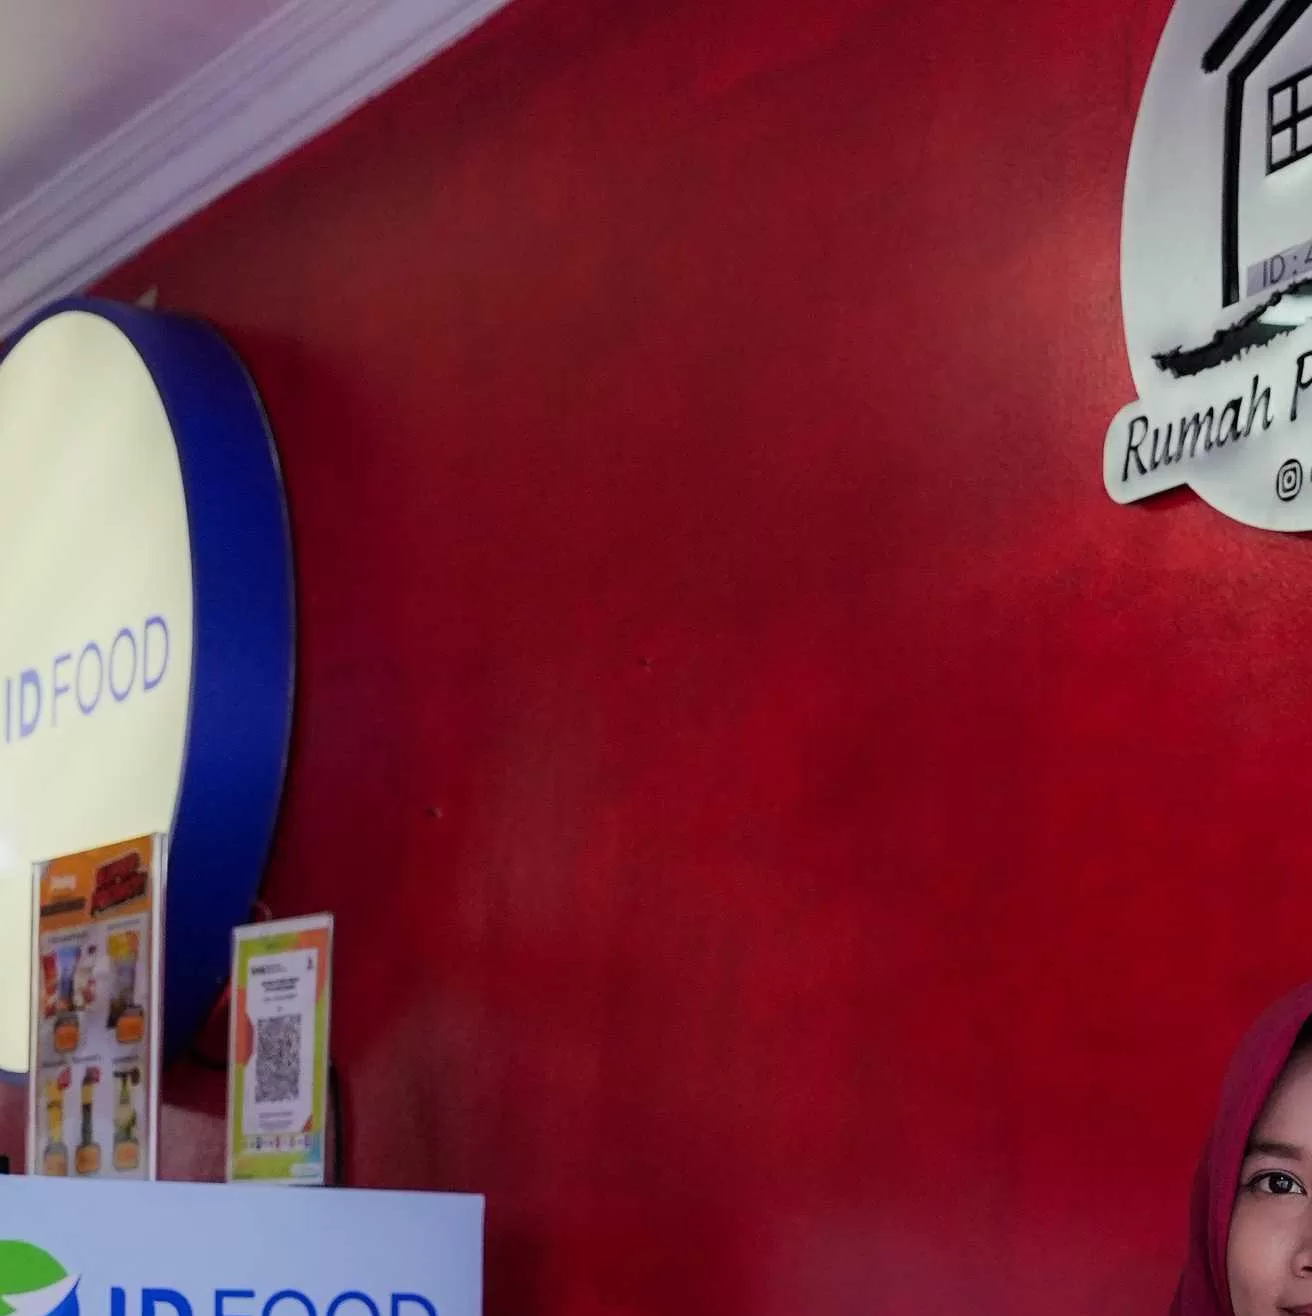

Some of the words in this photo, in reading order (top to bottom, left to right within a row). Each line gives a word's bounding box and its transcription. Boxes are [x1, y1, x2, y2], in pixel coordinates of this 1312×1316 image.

[1262, 253, 1286, 287] ID
[1122, 374, 1274, 482] Rumah
[2, 666, 43, 744] ID
[50, 614, 170, 729] FOOD
